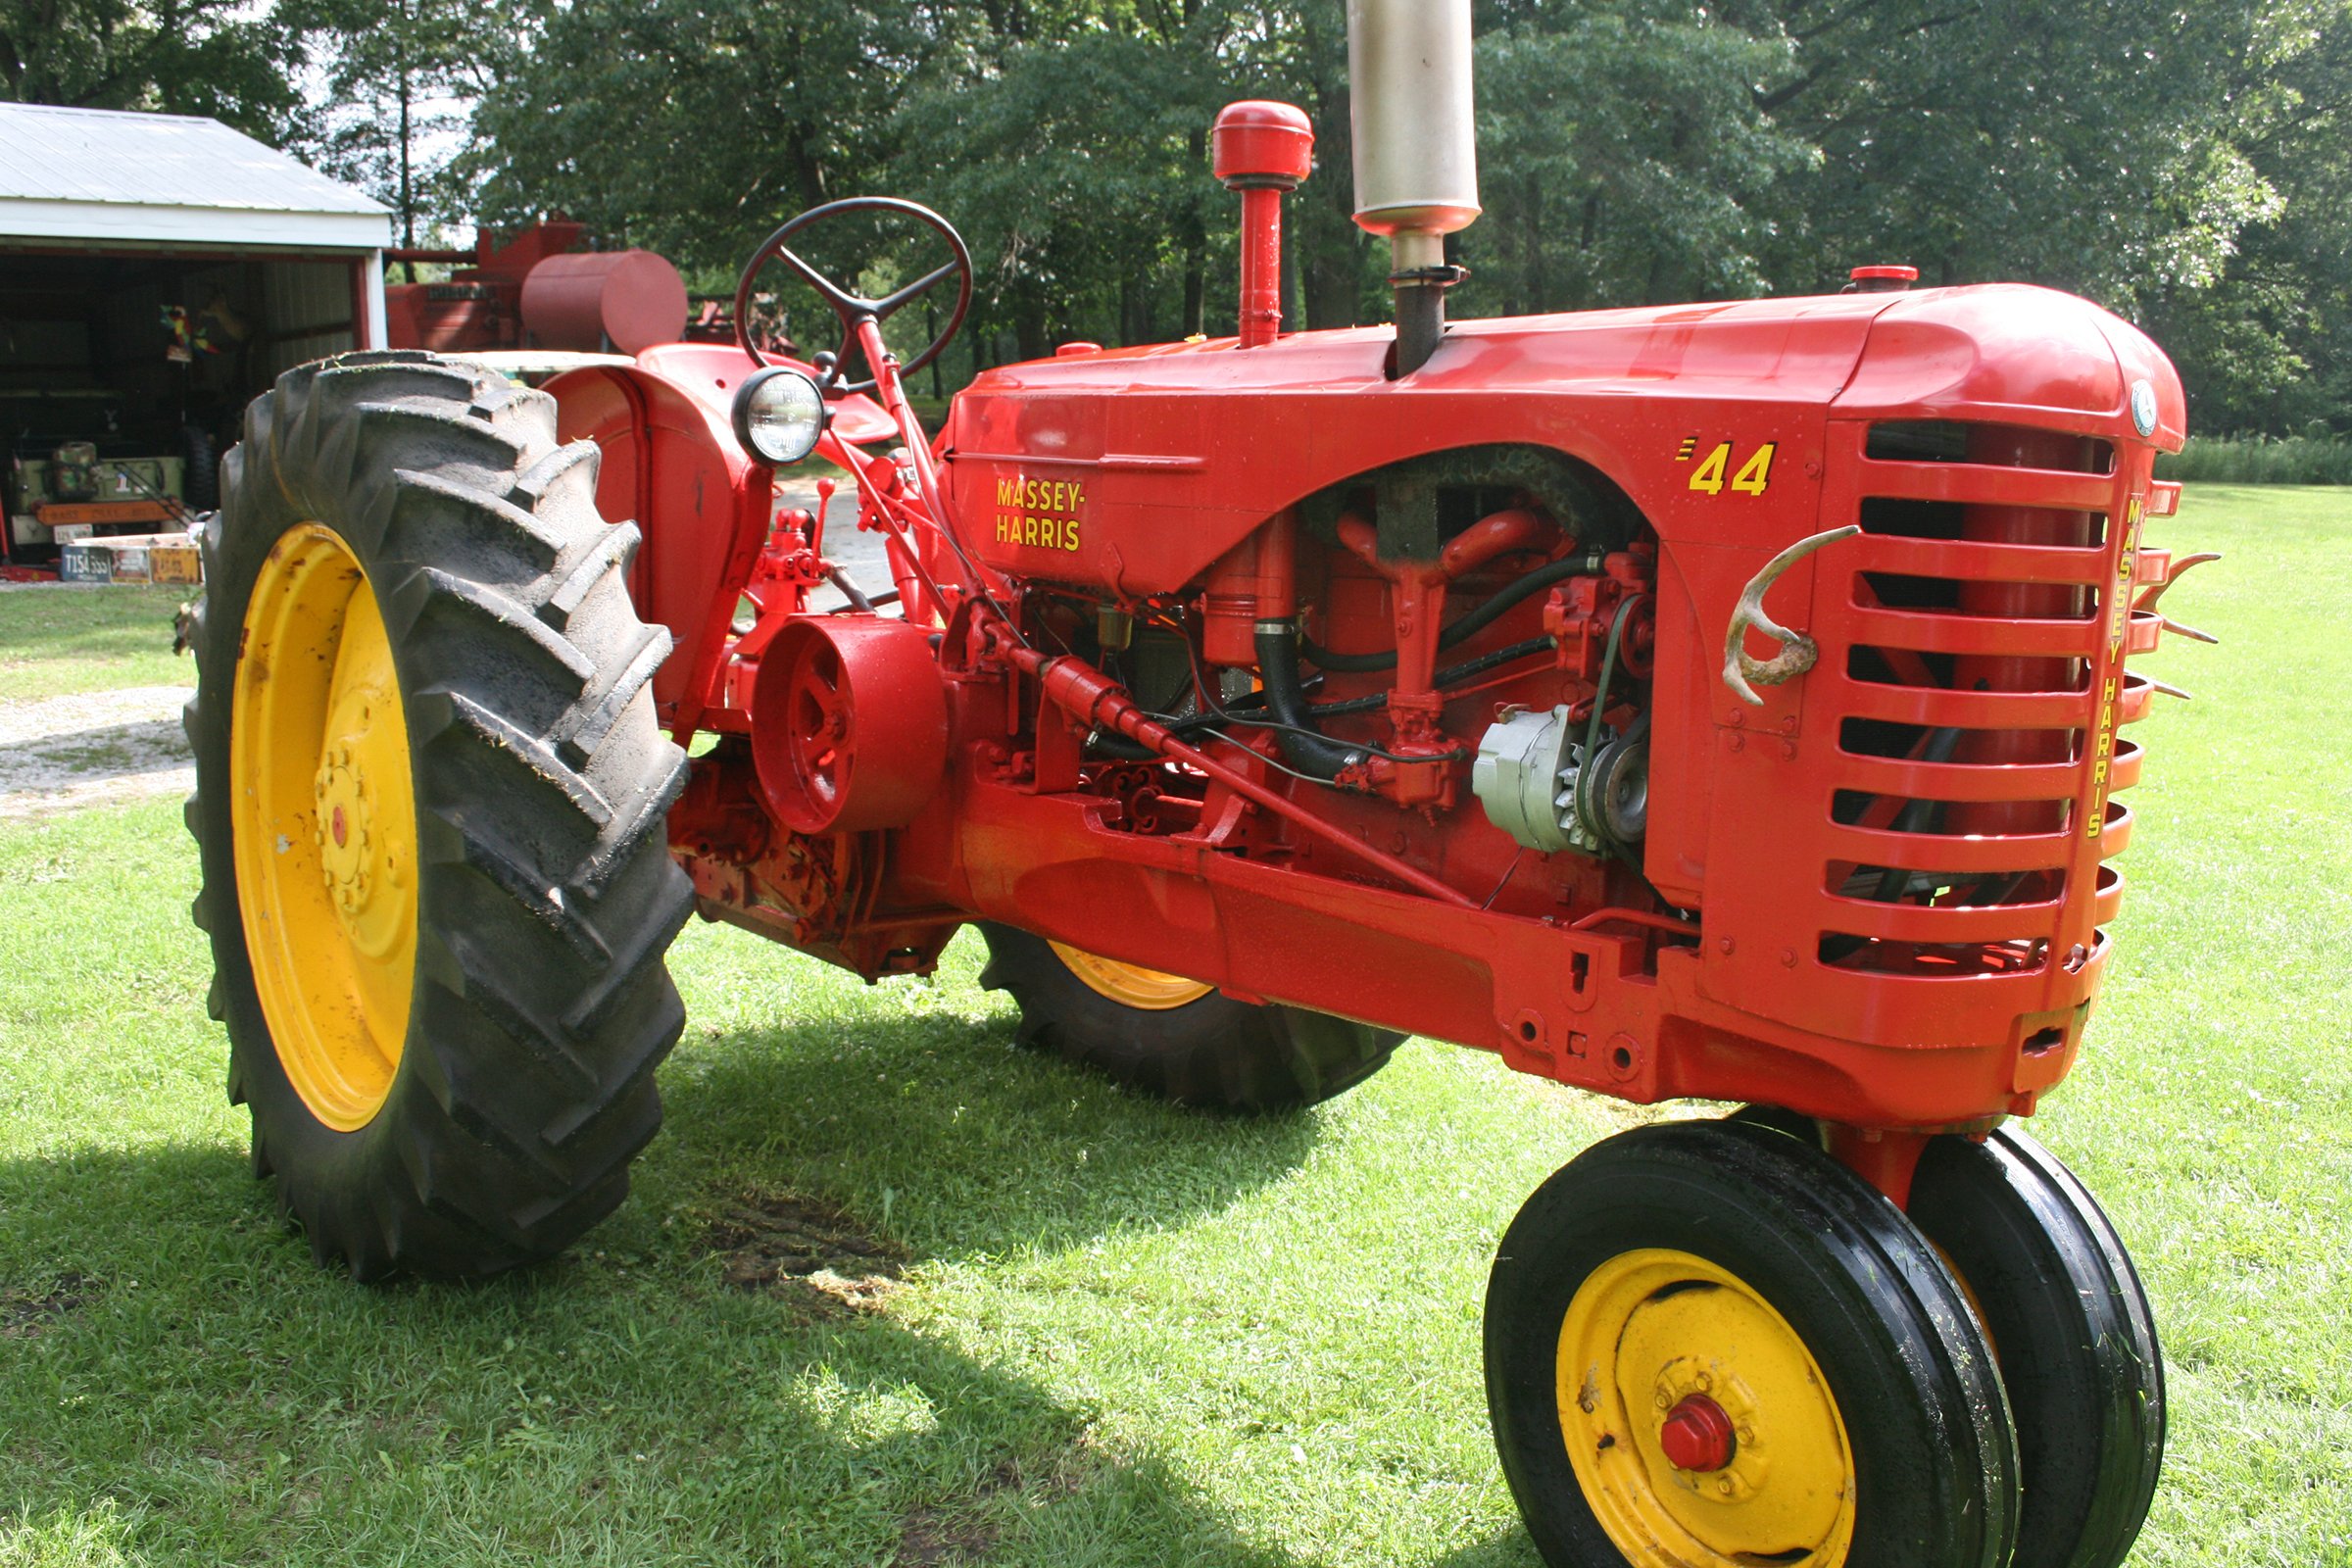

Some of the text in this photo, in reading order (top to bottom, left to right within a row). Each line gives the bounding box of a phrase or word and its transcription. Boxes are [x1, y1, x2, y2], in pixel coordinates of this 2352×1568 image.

[1689, 440, 1779, 496] 44
[996, 477, 1087, 513] MASSEY-
[996, 514, 1081, 553] HARRIS
[2086, 498, 2141, 839] MASSEY HARRIS
